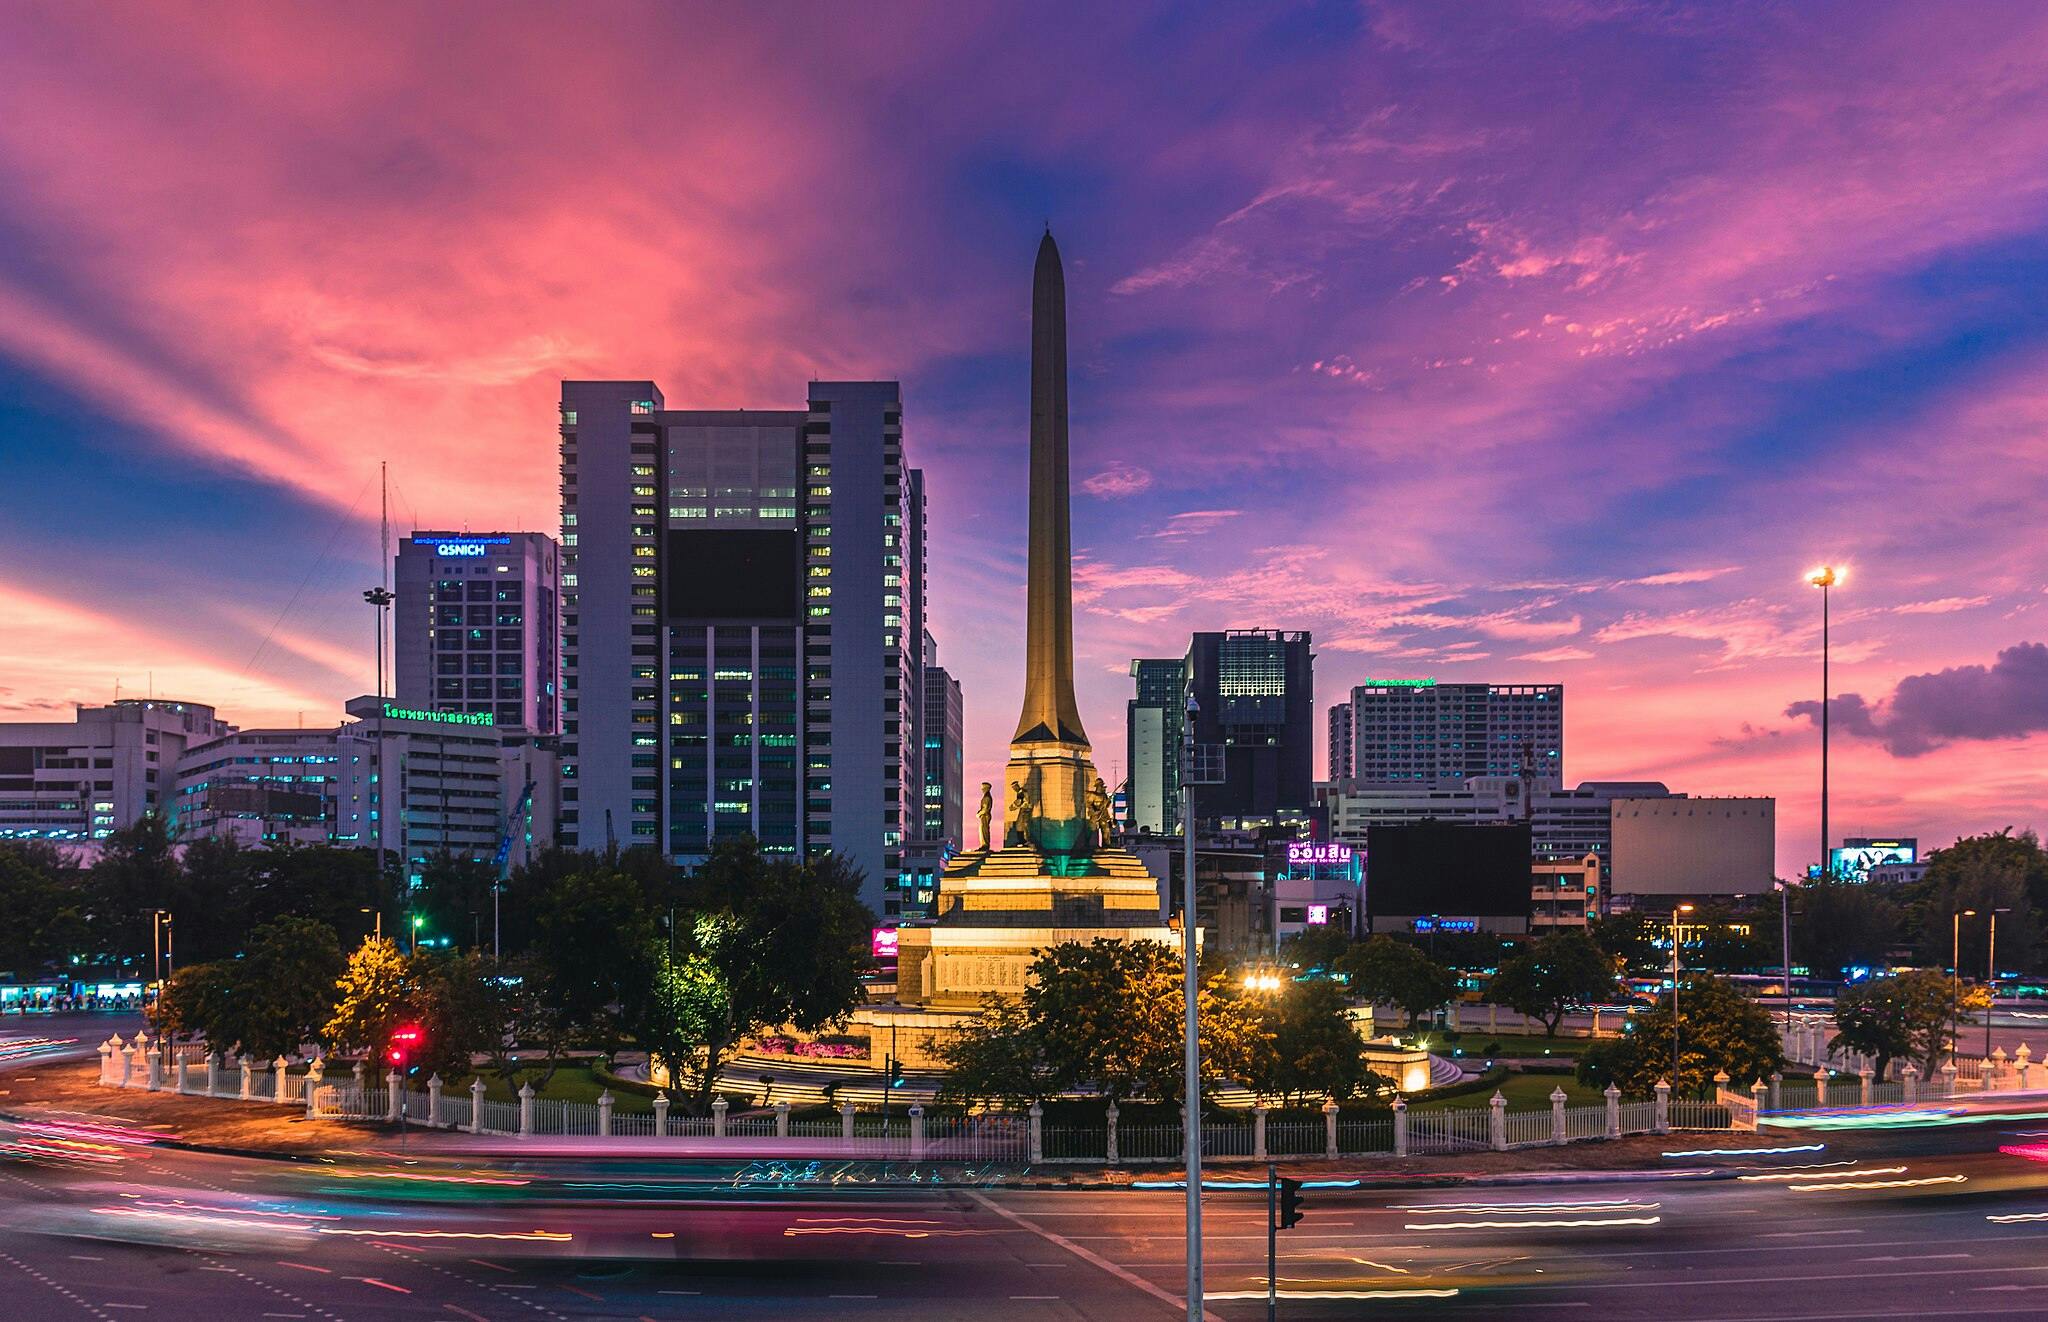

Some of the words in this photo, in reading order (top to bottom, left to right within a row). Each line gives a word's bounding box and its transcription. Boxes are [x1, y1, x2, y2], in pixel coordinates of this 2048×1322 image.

[438, 544, 485, 556] QSNICH
[1289, 844, 1351, 858] ออมสิน
